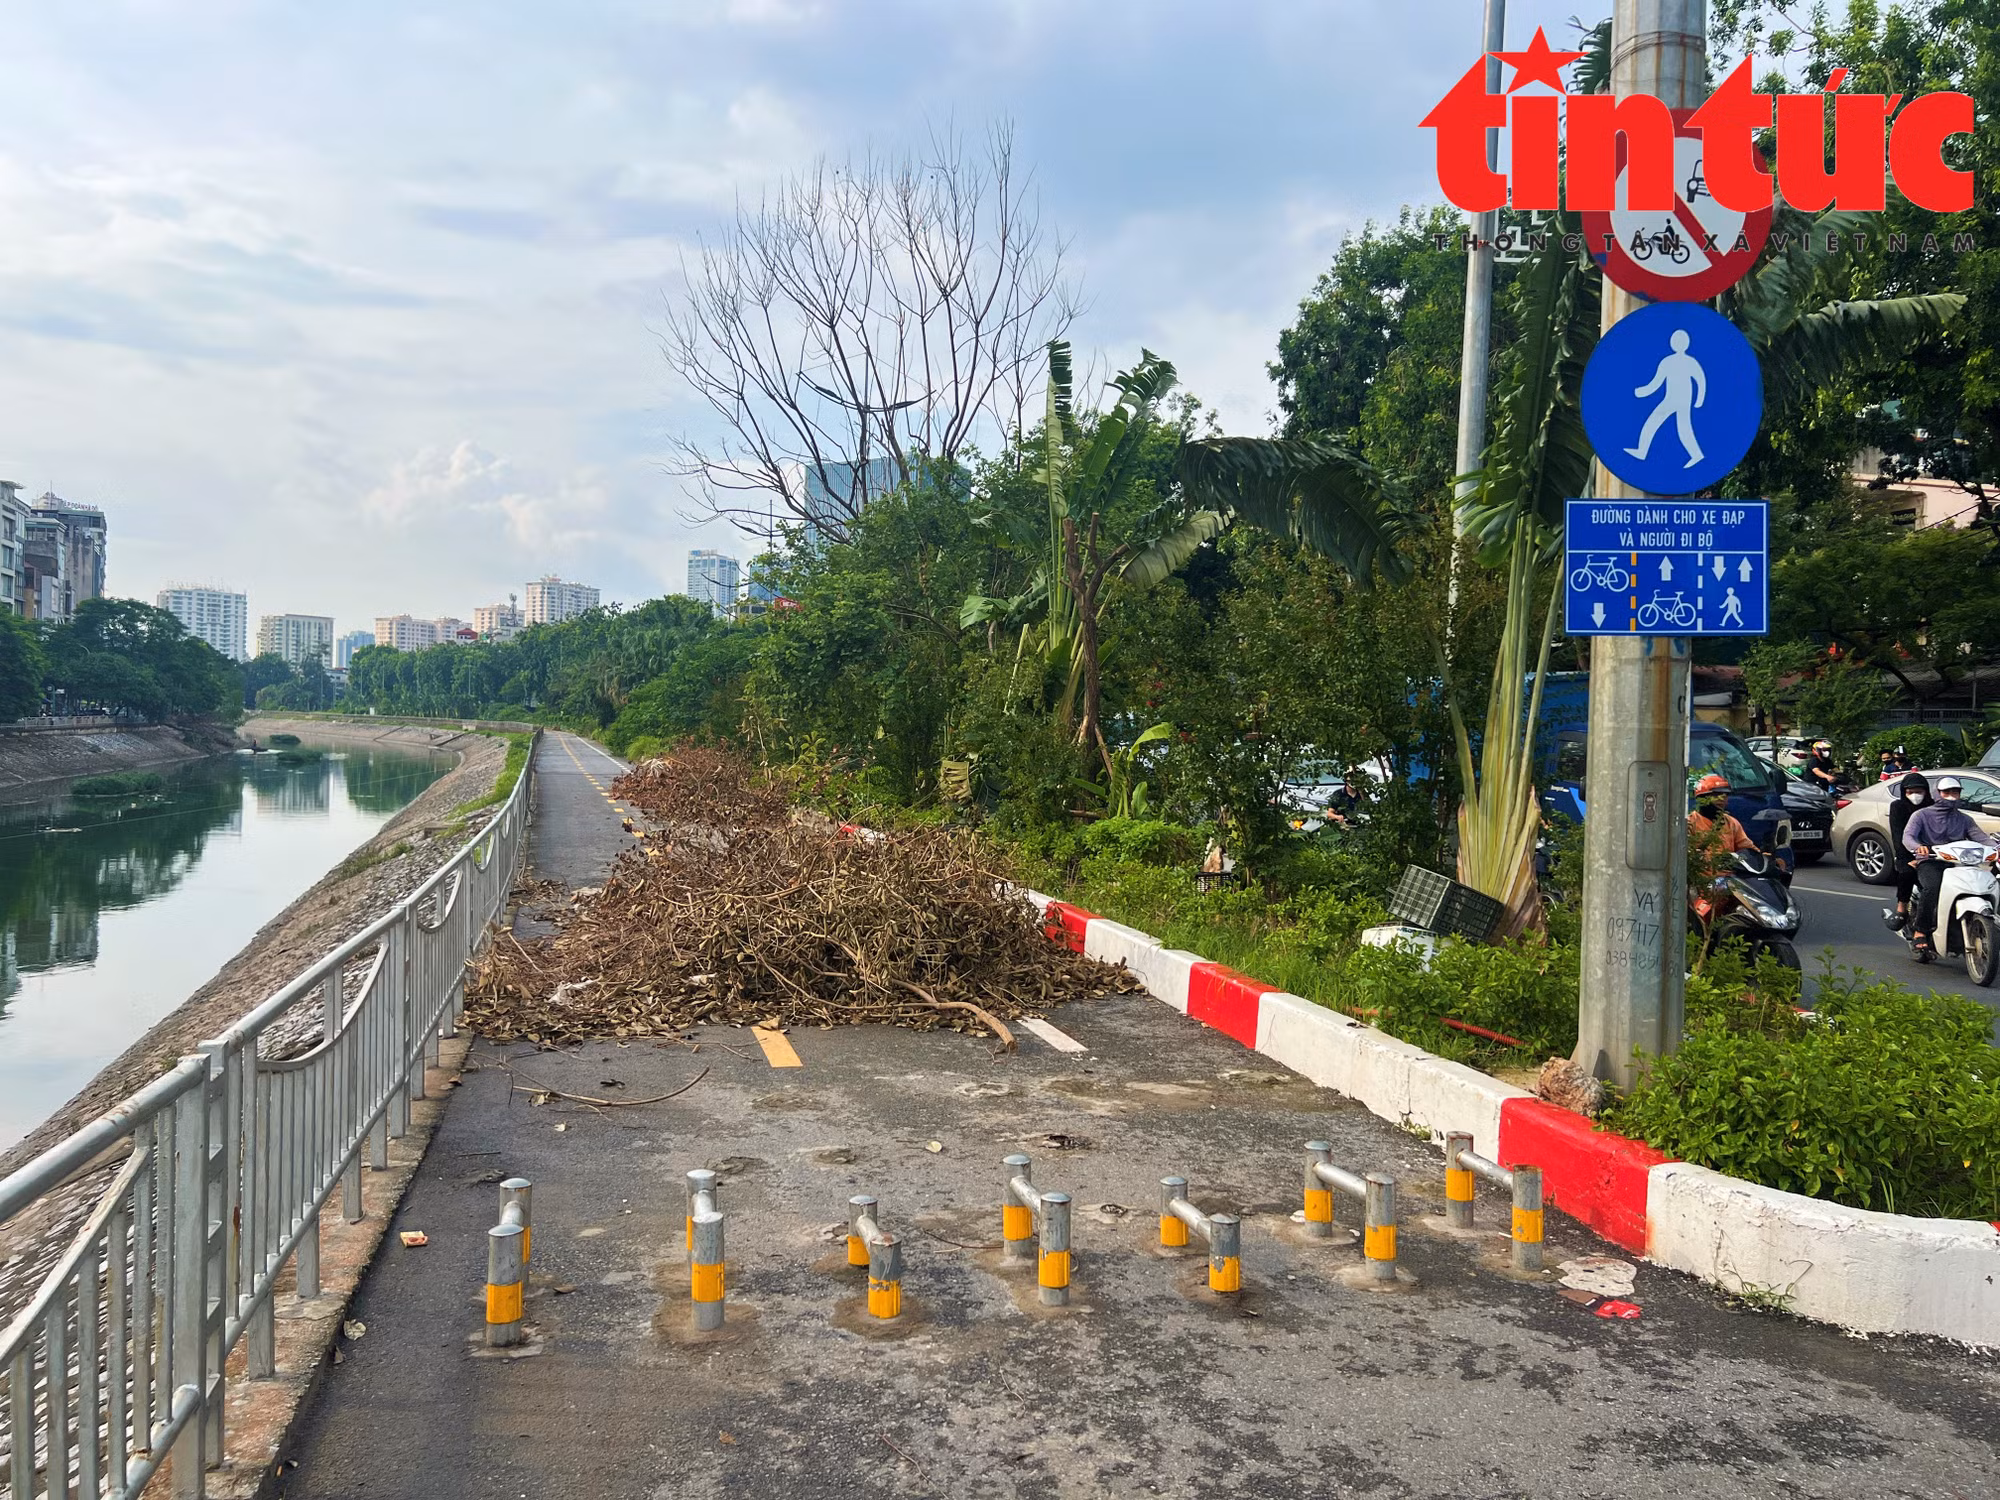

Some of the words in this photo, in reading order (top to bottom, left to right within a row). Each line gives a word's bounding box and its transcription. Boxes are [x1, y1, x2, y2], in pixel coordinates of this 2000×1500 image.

[1591, 505, 1631, 524] ĐƯỜNG
[1636, 505, 1668, 524] DÀNH
[1673, 509, 1696, 524] CHO
[1702, 510, 1716, 525] XE
[1722, 510, 1745, 528] ĐẠP
[1619, 528, 1634, 547] VÀ
[1640, 528, 1675, 547] NGƯỜI
[1680, 532, 1692, 547] ĐI
[1698, 529, 1713, 550] BỘ
